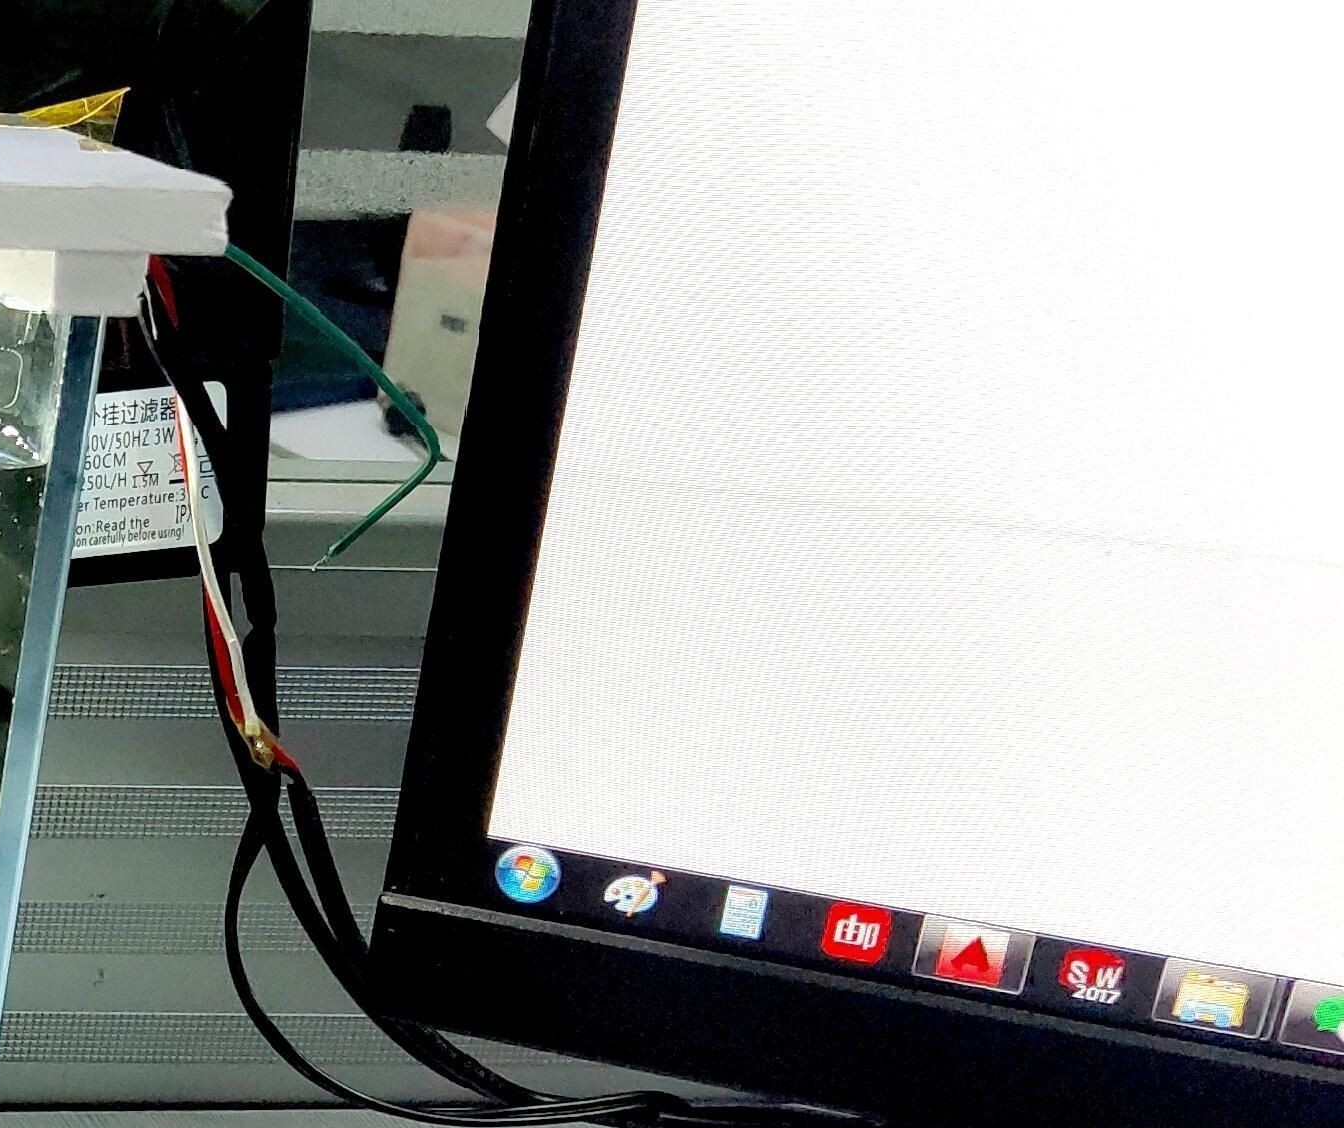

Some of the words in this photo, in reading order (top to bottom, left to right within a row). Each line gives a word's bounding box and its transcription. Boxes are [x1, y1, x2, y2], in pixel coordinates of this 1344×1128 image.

[87, 429, 150, 453] 0V/50HZ
[154, 426, 176, 446] 3W
[130, 517, 150, 533] the
[89, 532, 126, 547] carefully
[127, 528, 156, 543] before
[1071, 984, 1121, 1004] 2017
